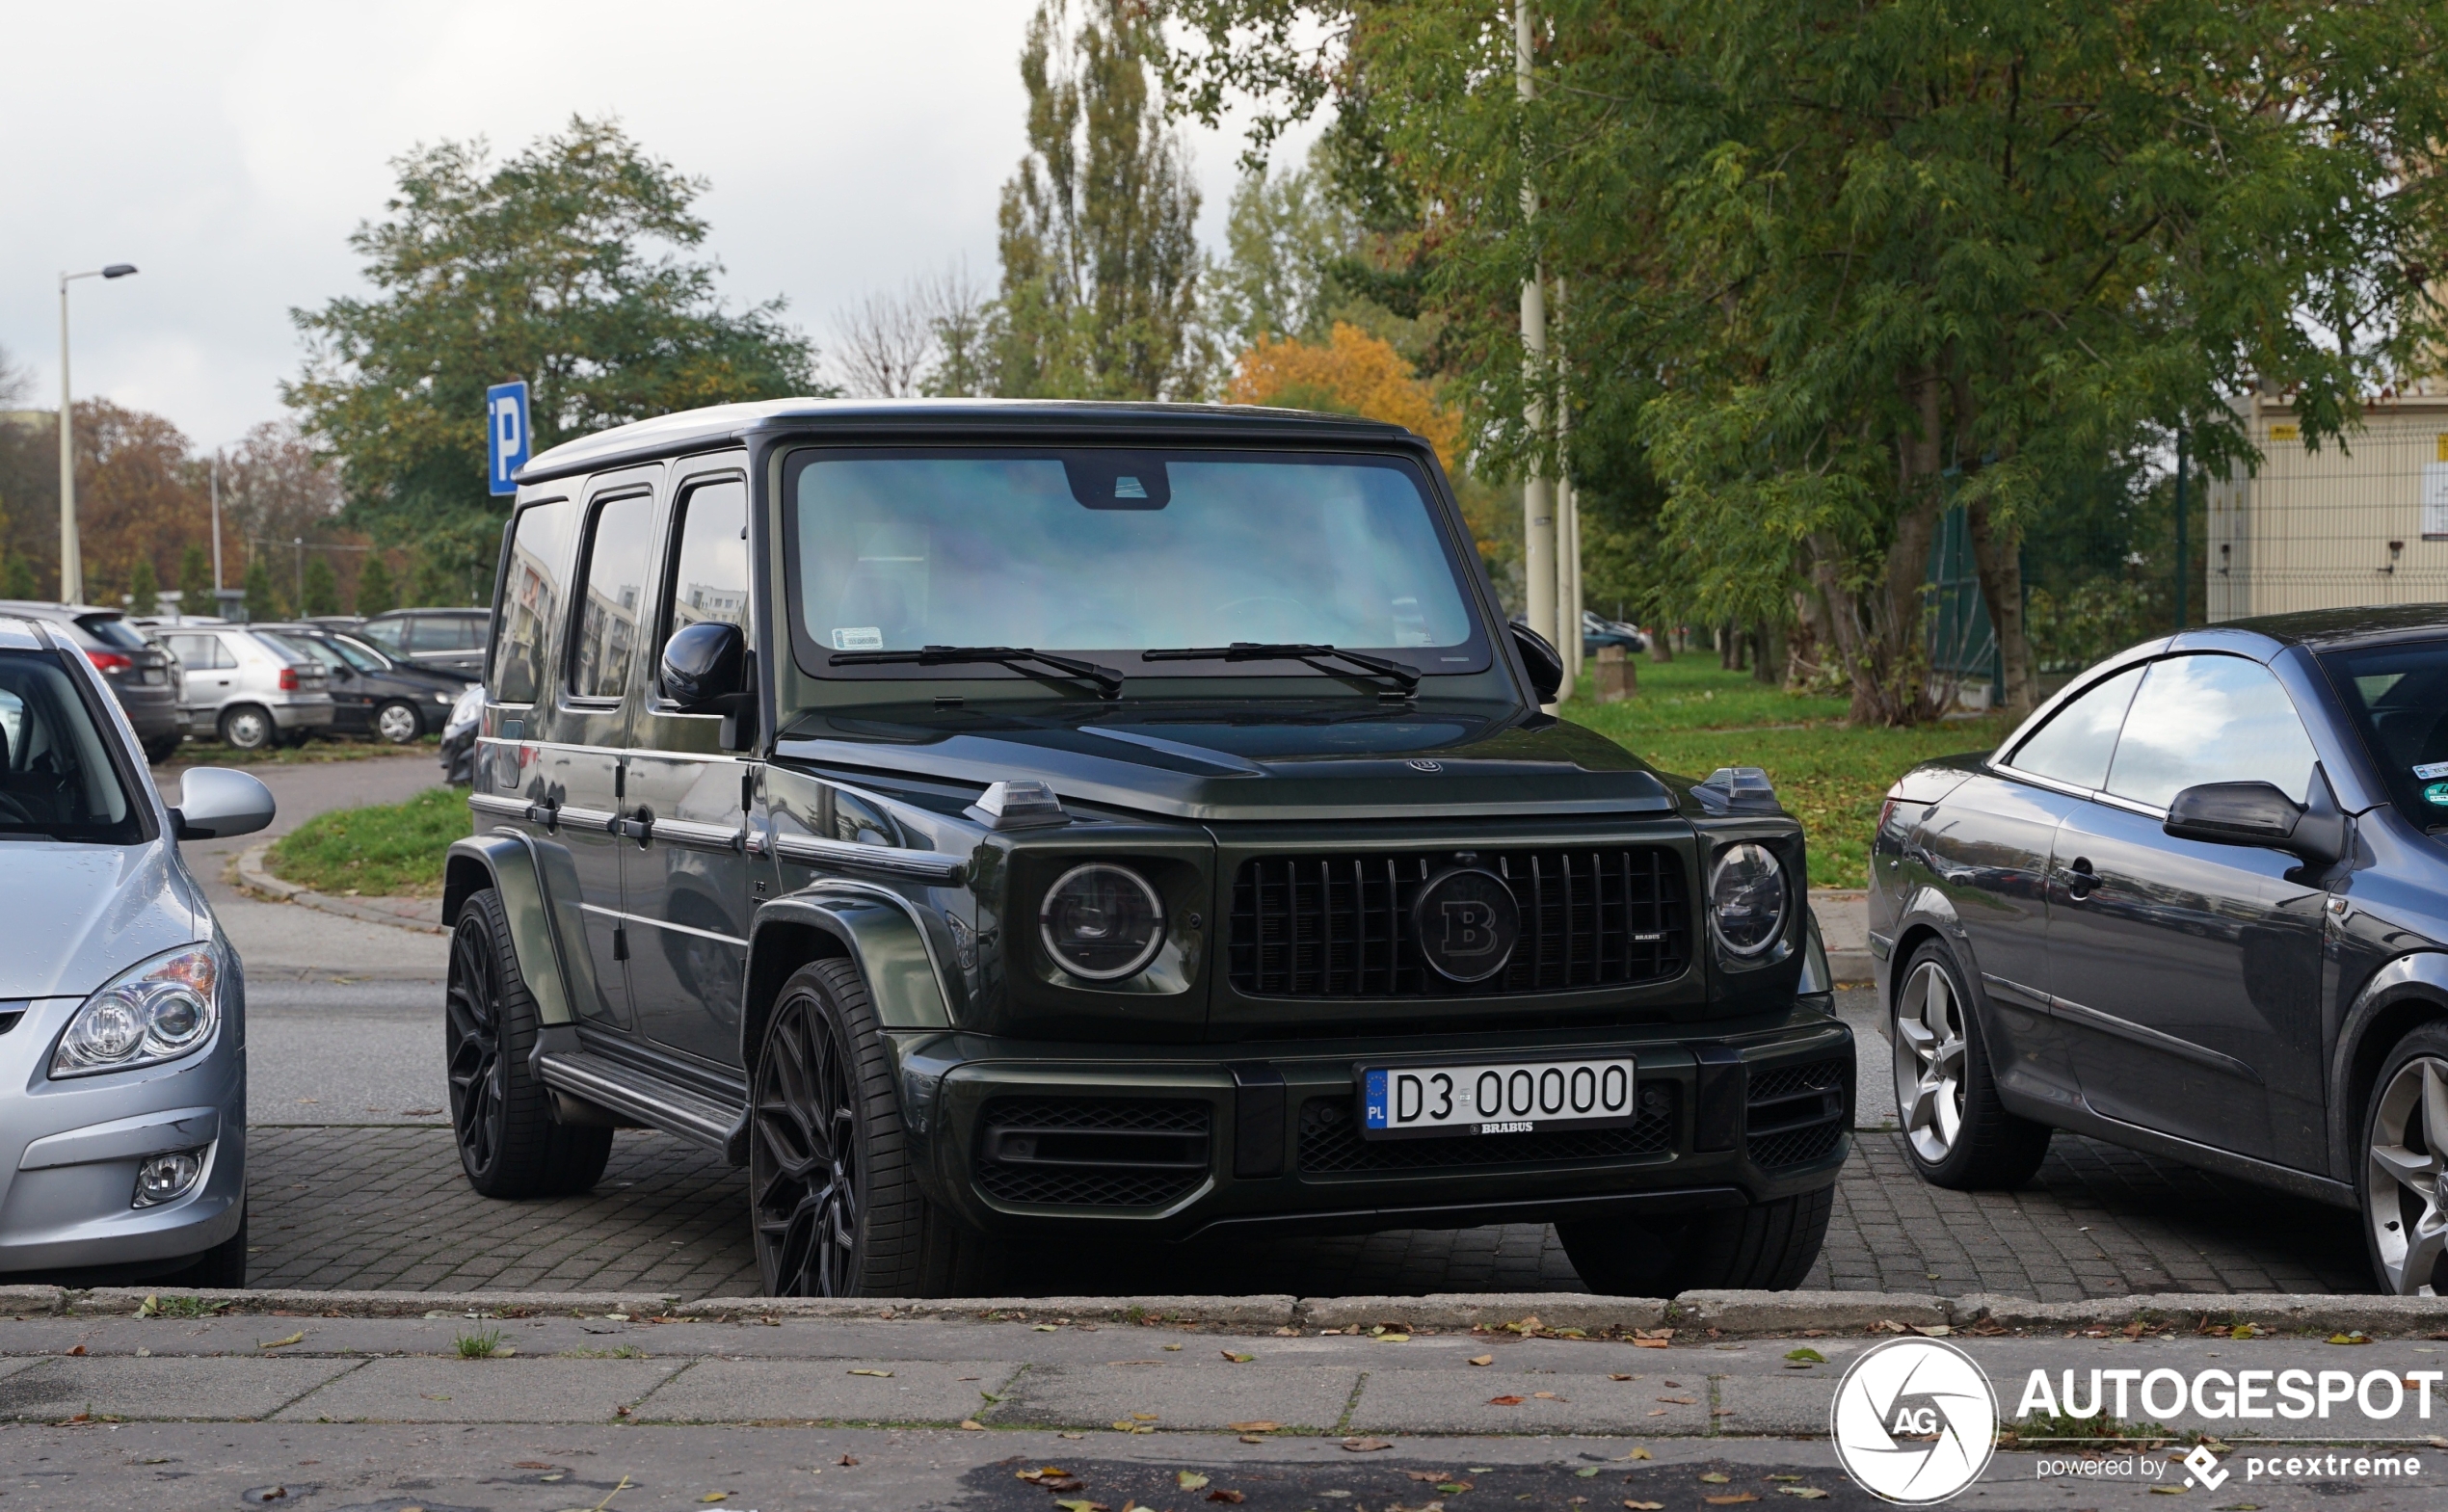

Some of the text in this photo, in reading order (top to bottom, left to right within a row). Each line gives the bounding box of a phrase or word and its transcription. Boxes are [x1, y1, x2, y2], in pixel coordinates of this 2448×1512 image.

[496, 396, 520, 481] P
[1368, 1106, 1385, 1120] PL
[1397, 1073, 1453, 1123] D3
[1481, 1122, 1533, 1134] BRABUS
